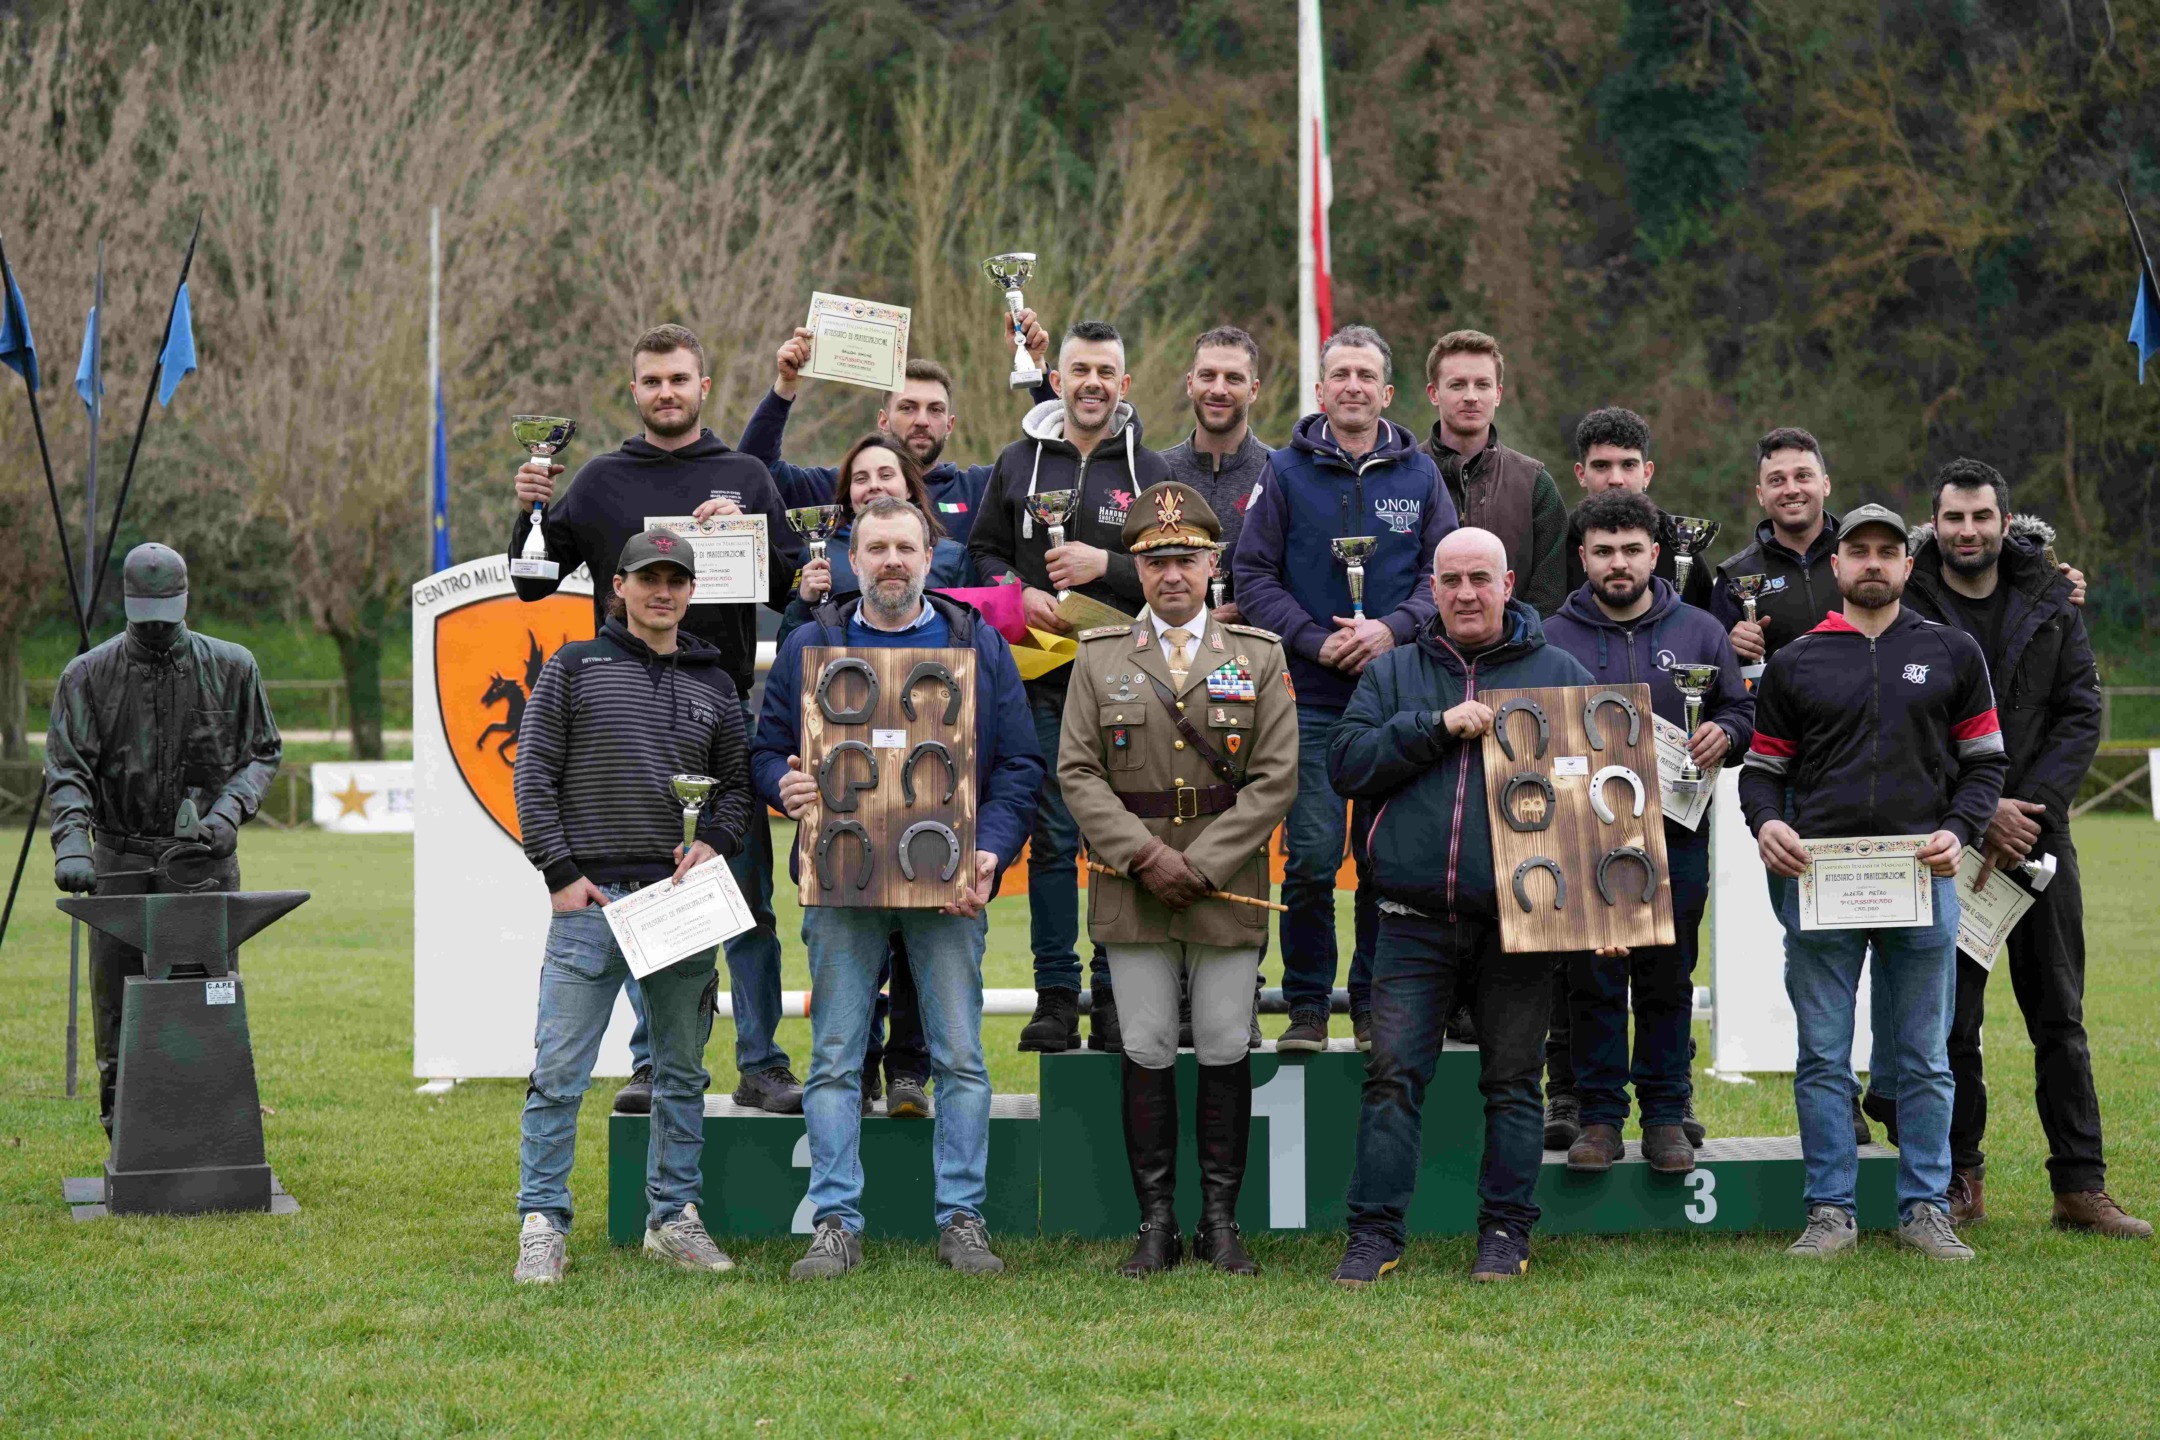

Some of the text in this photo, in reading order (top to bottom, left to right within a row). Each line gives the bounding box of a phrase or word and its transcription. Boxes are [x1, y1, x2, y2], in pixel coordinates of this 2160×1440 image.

[414, 573, 471, 606] CENTRO
[475, 562, 510, 584] MILI
[1824, 873, 1854, 882] ATTESTATO
[1864, 871, 1906, 880] PARTECIPAZIONE
[1251, 1065, 1306, 1228] 1
[1684, 1168, 1718, 1224] 3
